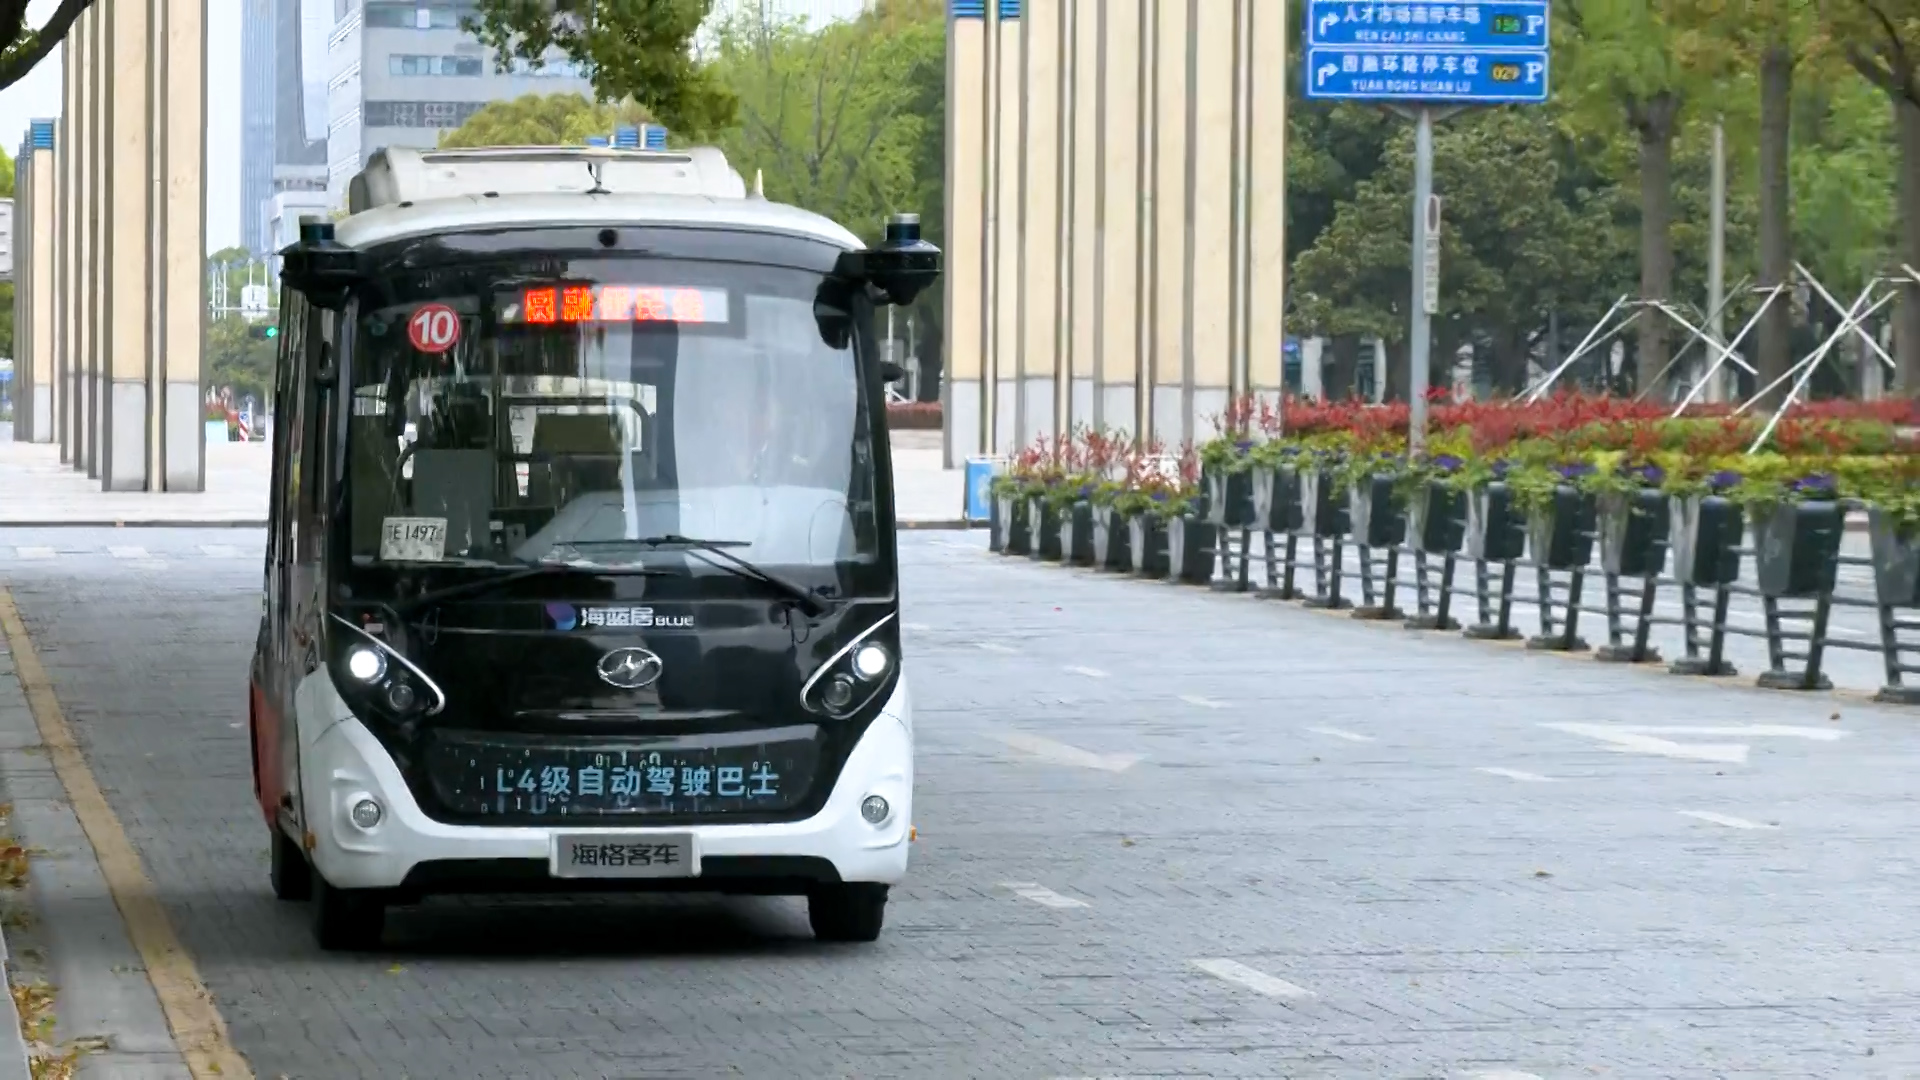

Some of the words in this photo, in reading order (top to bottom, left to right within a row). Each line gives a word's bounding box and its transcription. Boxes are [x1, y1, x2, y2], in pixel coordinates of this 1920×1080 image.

[1527, 15, 1544, 35] P
[1525, 62, 1543, 82] P
[414, 311, 452, 343] 10
[497, 765, 780, 796] L4级自动驾驶巴士
[571, 843, 680, 866] 海格客车
